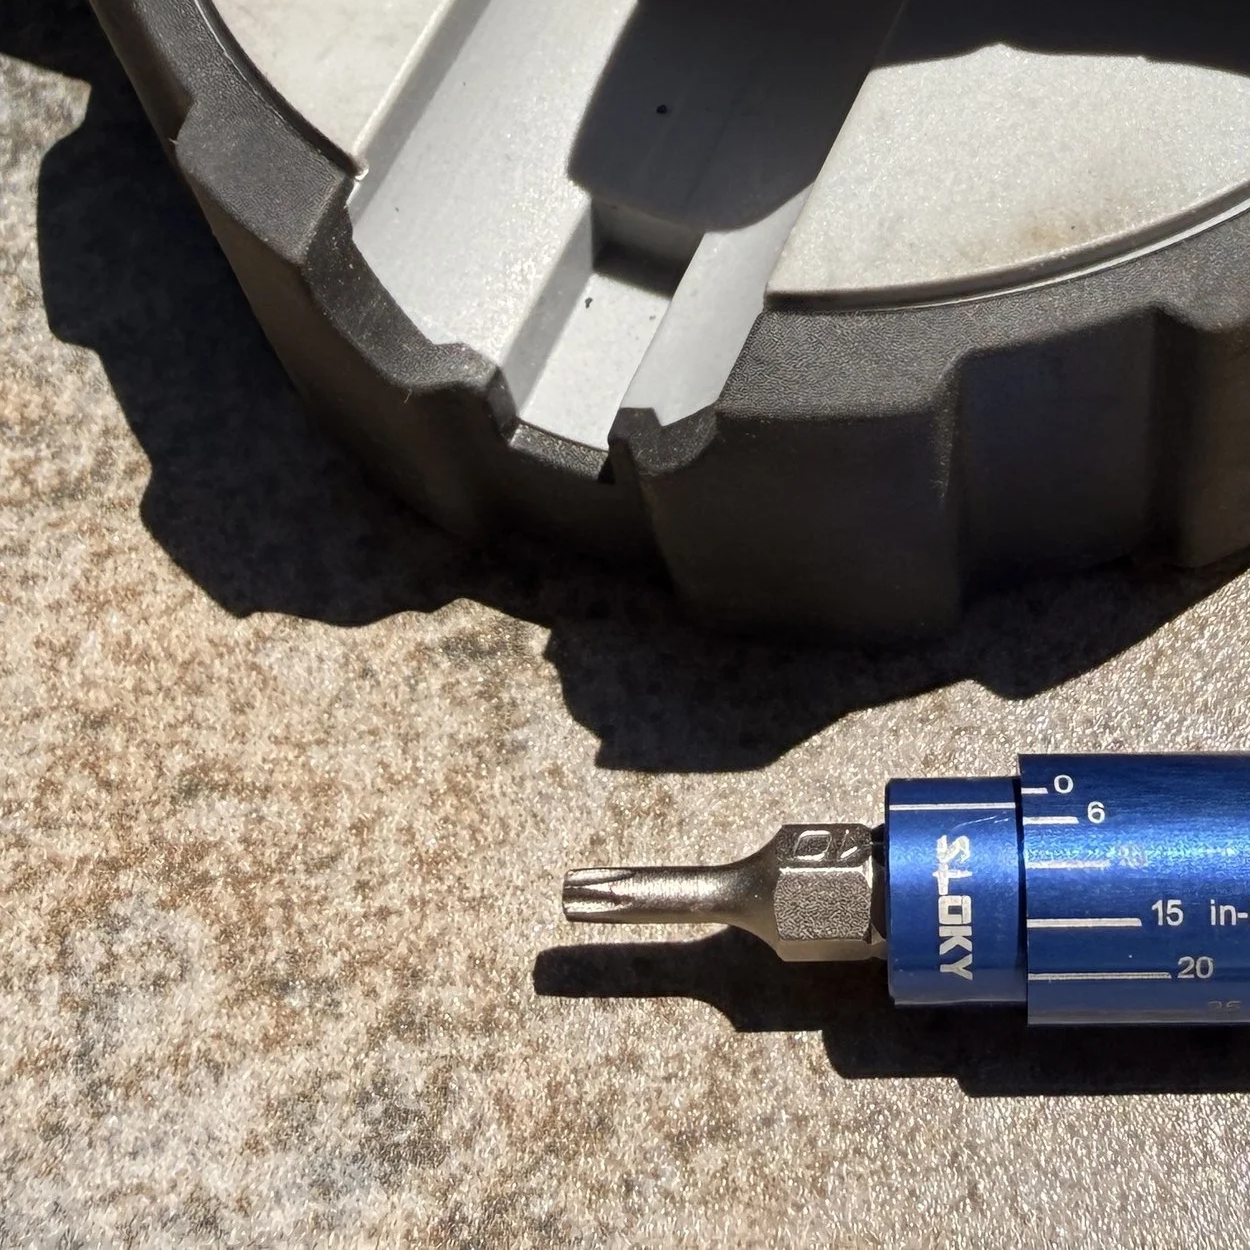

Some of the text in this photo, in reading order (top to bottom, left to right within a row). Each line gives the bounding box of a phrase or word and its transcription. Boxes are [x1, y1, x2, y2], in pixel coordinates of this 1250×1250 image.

[1053, 774, 1075, 794] 0
[1086, 800, 1106, 824] 6
[1151, 899, 1185, 927] 15
[1176, 955, 1214, 980] 20
